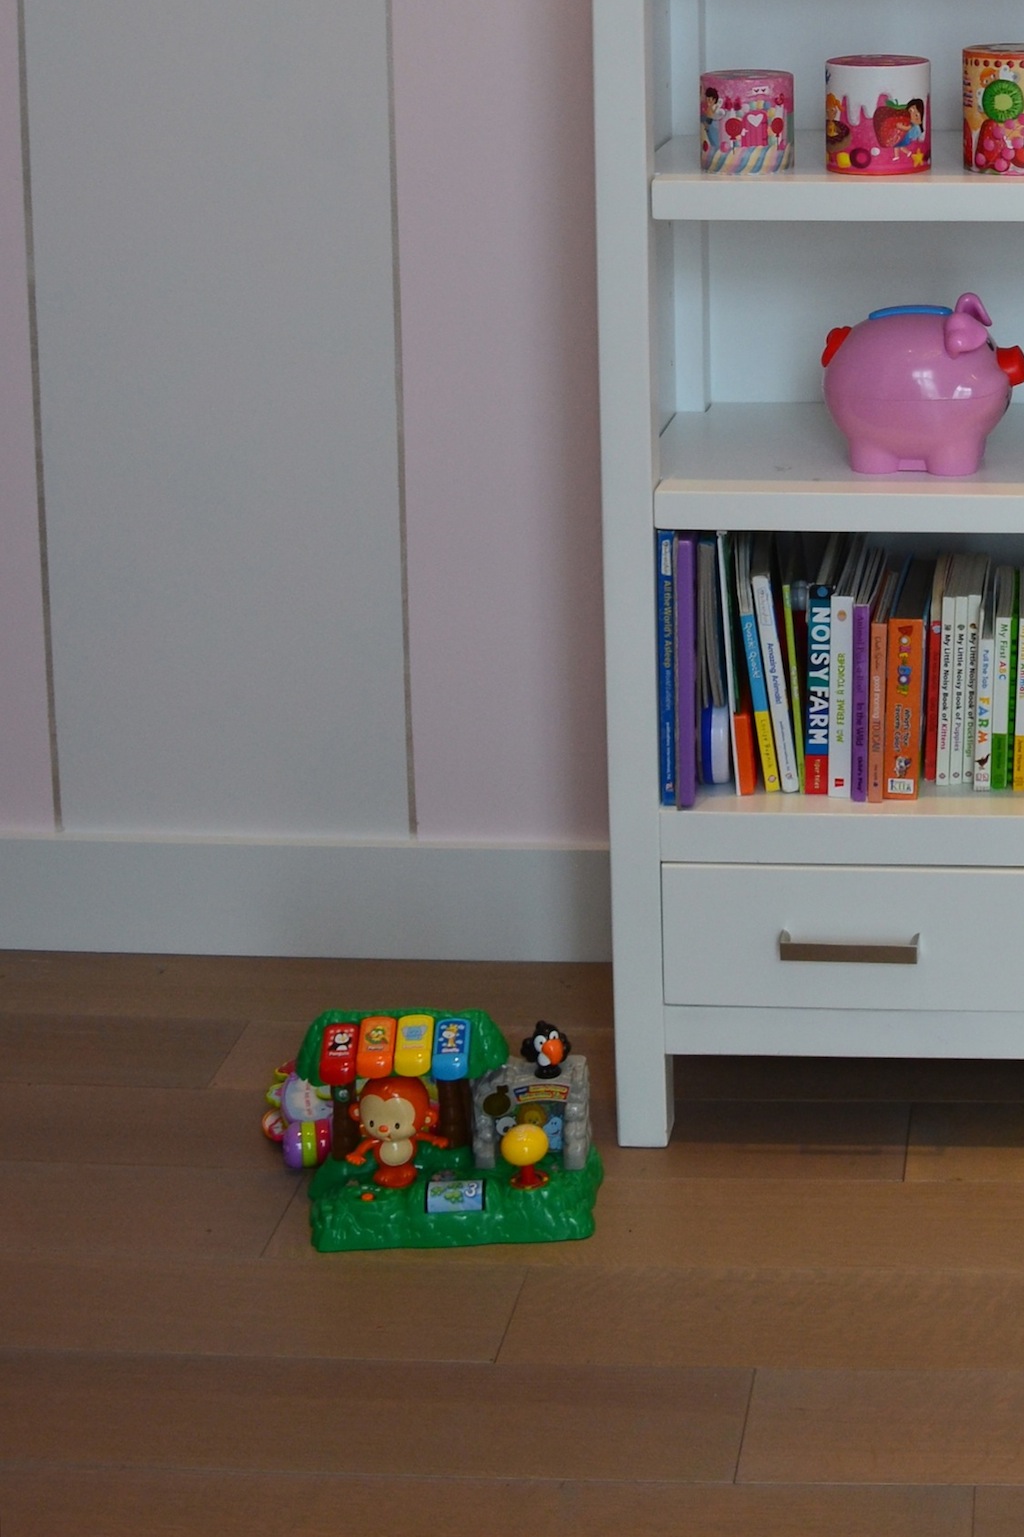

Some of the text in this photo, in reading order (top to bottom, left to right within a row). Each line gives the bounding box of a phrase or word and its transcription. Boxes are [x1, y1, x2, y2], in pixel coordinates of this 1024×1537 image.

[943, 634, 951, 646] My
[957, 634, 964, 644] My
[969, 632, 977, 644] My
[767, 643, 777, 673] Amazing
[969, 646, 977, 666] Little
[999, 624, 1008, 680] My First ABC
[808, 607, 830, 745] NOISY FARM
[941, 670, 950, 689] Noisy
[955, 669, 963, 689] Noisy
[968, 668, 976, 688] Noisy
[942, 713, 948, 721] of
[956, 712, 962, 720] of
[977, 697, 990, 744] FARM
[940, 724, 948, 750] Kittens
[953, 723, 961, 751] Puppies
[465, 1182, 477, 1197] 3
